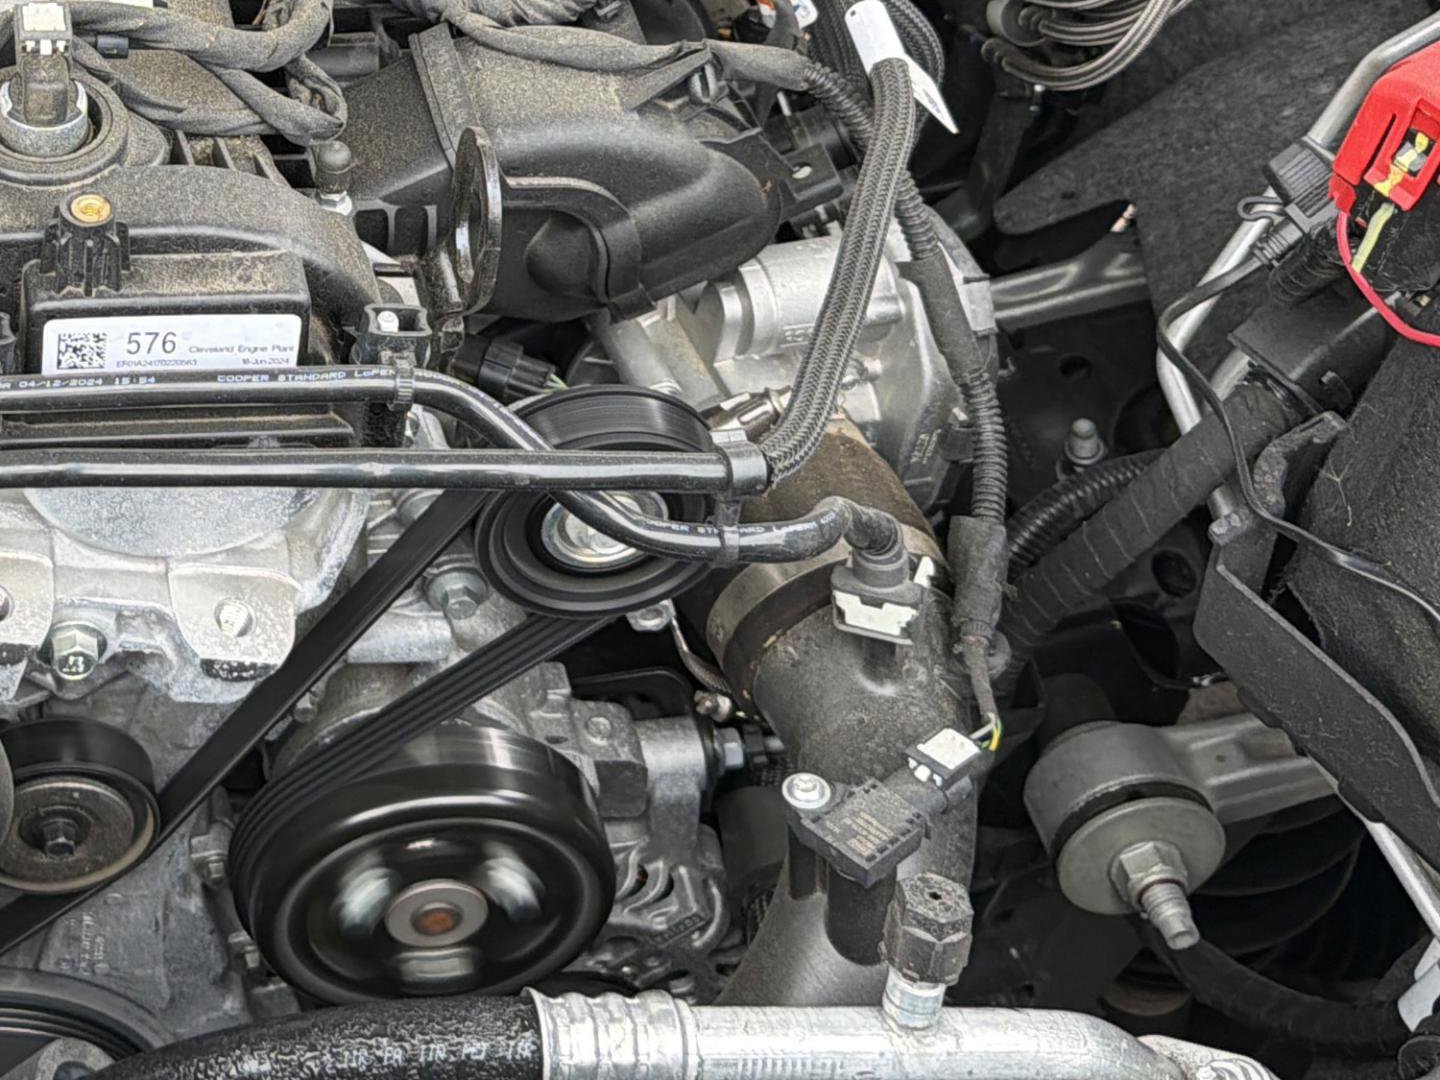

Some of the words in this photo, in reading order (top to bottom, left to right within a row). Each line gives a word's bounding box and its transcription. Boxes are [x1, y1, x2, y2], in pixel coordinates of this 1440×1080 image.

[126, 331, 177, 355] 576
[188, 345, 234, 354] Cleveland
[237, 344, 268, 355] Engine
[271, 343, 295, 353] Plant
[18, 376, 103, 389] 04/12/2024
[216, 373, 270, 383] COOPER
[277, 370, 347, 382] STANDARD
